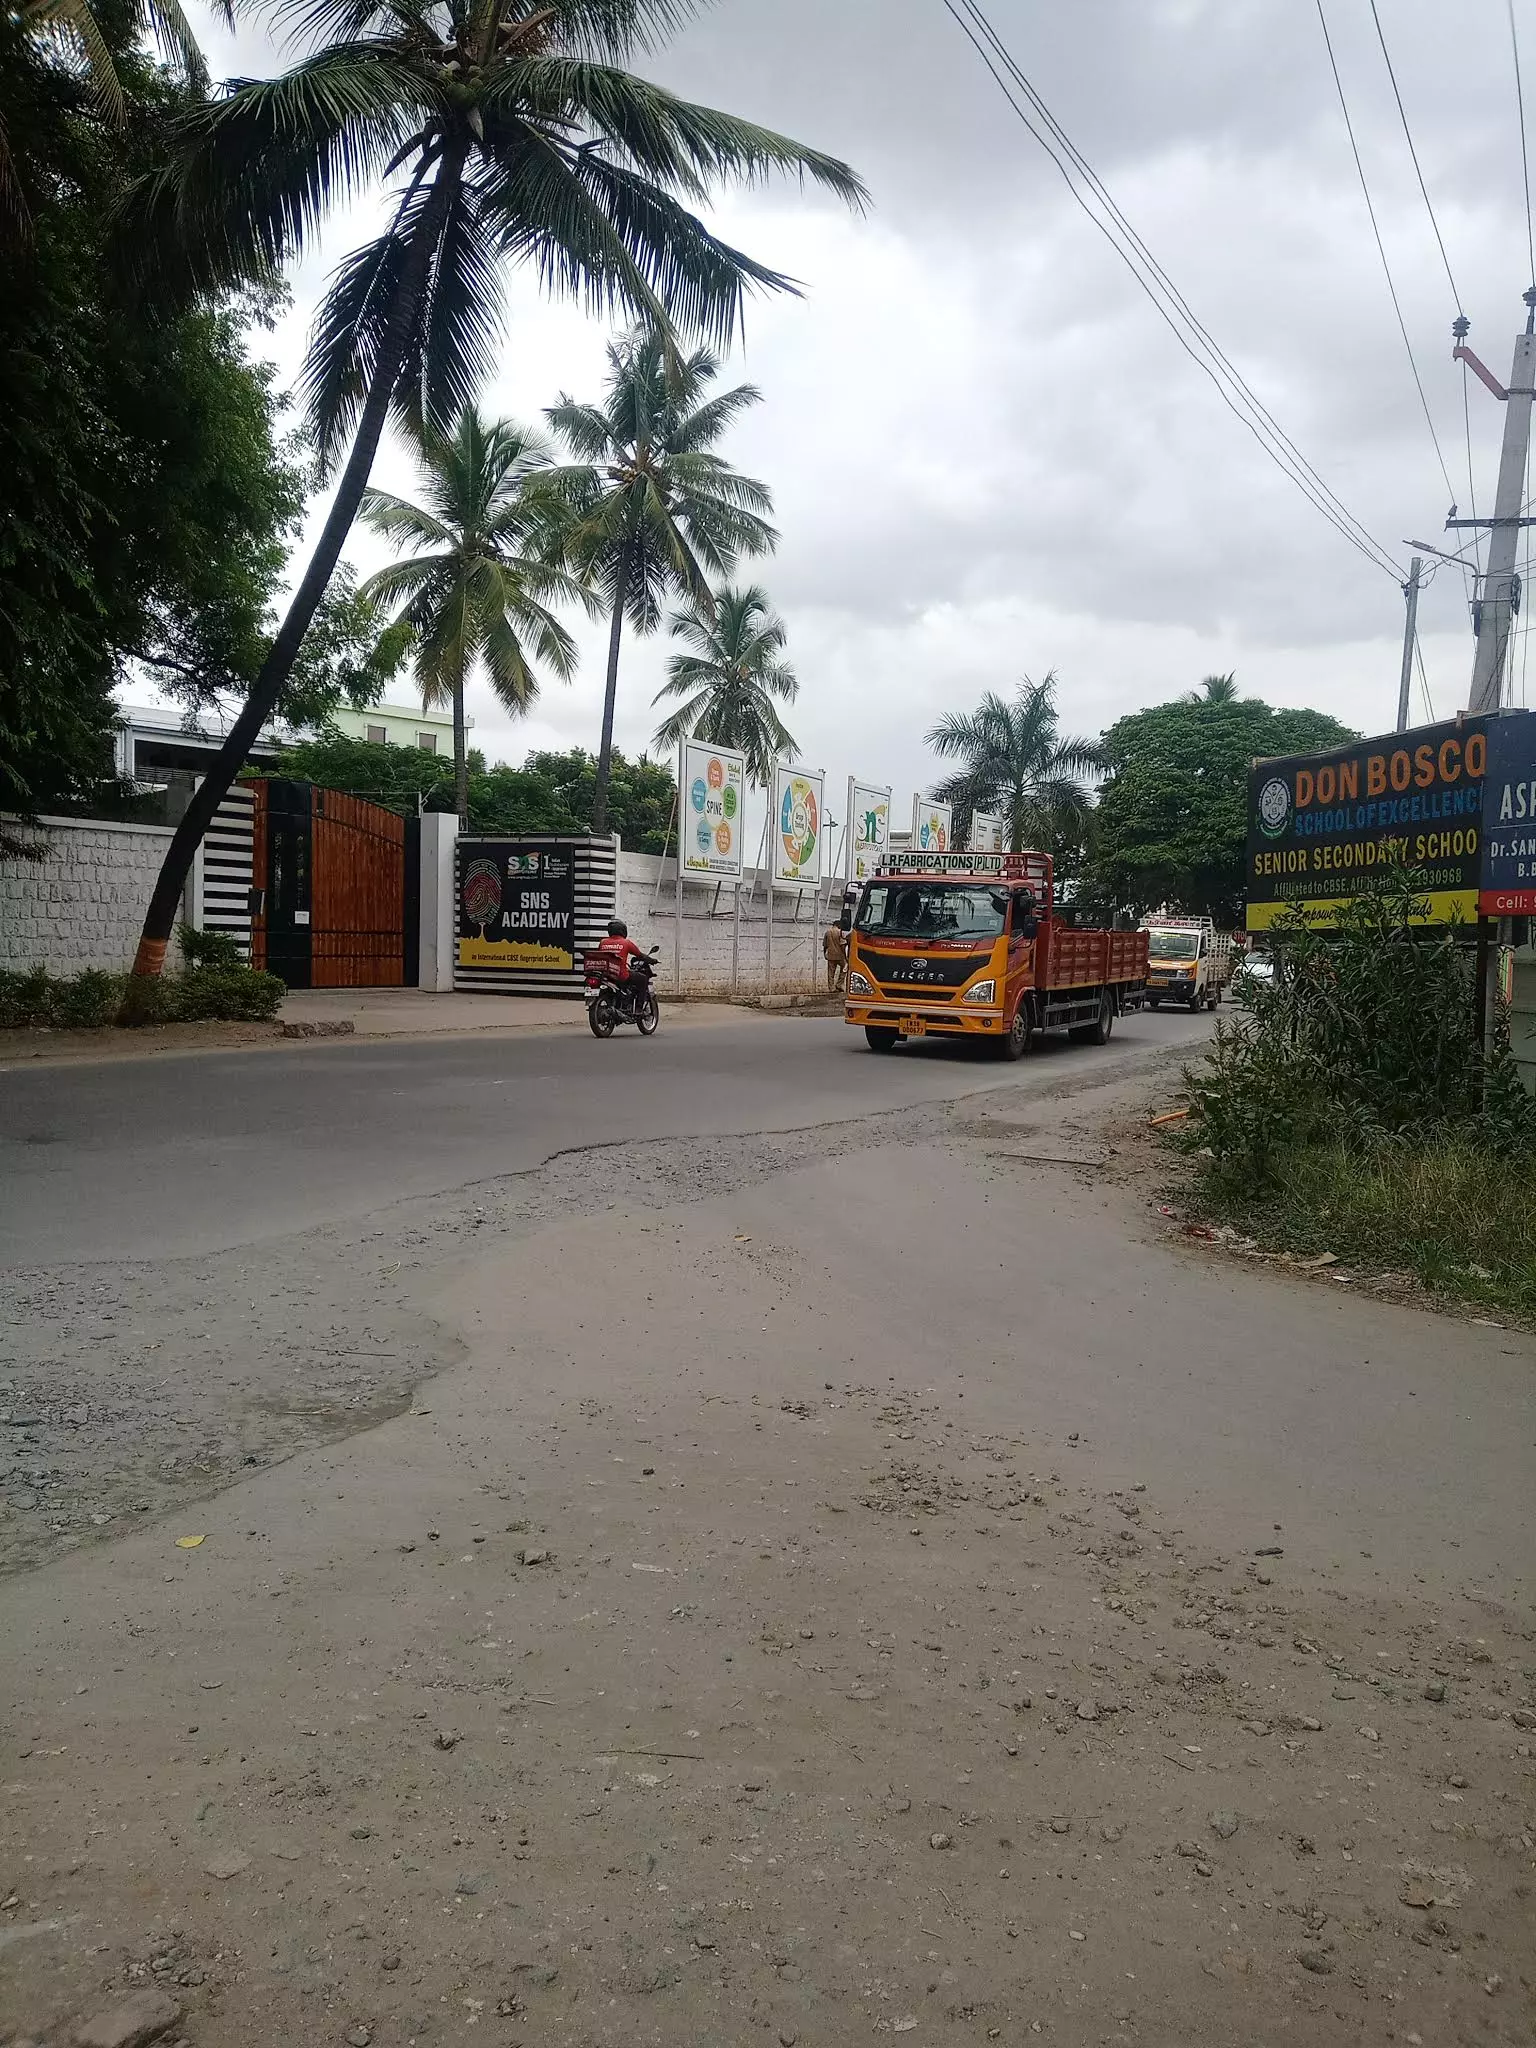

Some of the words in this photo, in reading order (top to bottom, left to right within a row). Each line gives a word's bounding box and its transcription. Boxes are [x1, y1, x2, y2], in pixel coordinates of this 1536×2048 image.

[1295, 760, 1358, 808] DON
[1367, 734, 1486, 796] BOSCO
[707, 800, 722, 816] SPINE
[1295, 807, 1354, 837] SCHOOL
[1356, 803, 1377, 829] OF
[1378, 787, 1482, 825] EXCELLENC
[1255, 849, 1307, 875] SENIOR
[1416, 828, 1477, 860] SCHOO
[1313, 880, 1323, 894] to
[520, 892, 549, 909] SNS
[1496, 895, 1528, 909] Cell:
[502, 912, 570, 928] ACADEMY
[477, 953, 506, 961] International
[506, 954, 519, 962] CBSE
[544, 955, 560, 963] School
[892, 970, 945, 981] EICHER
